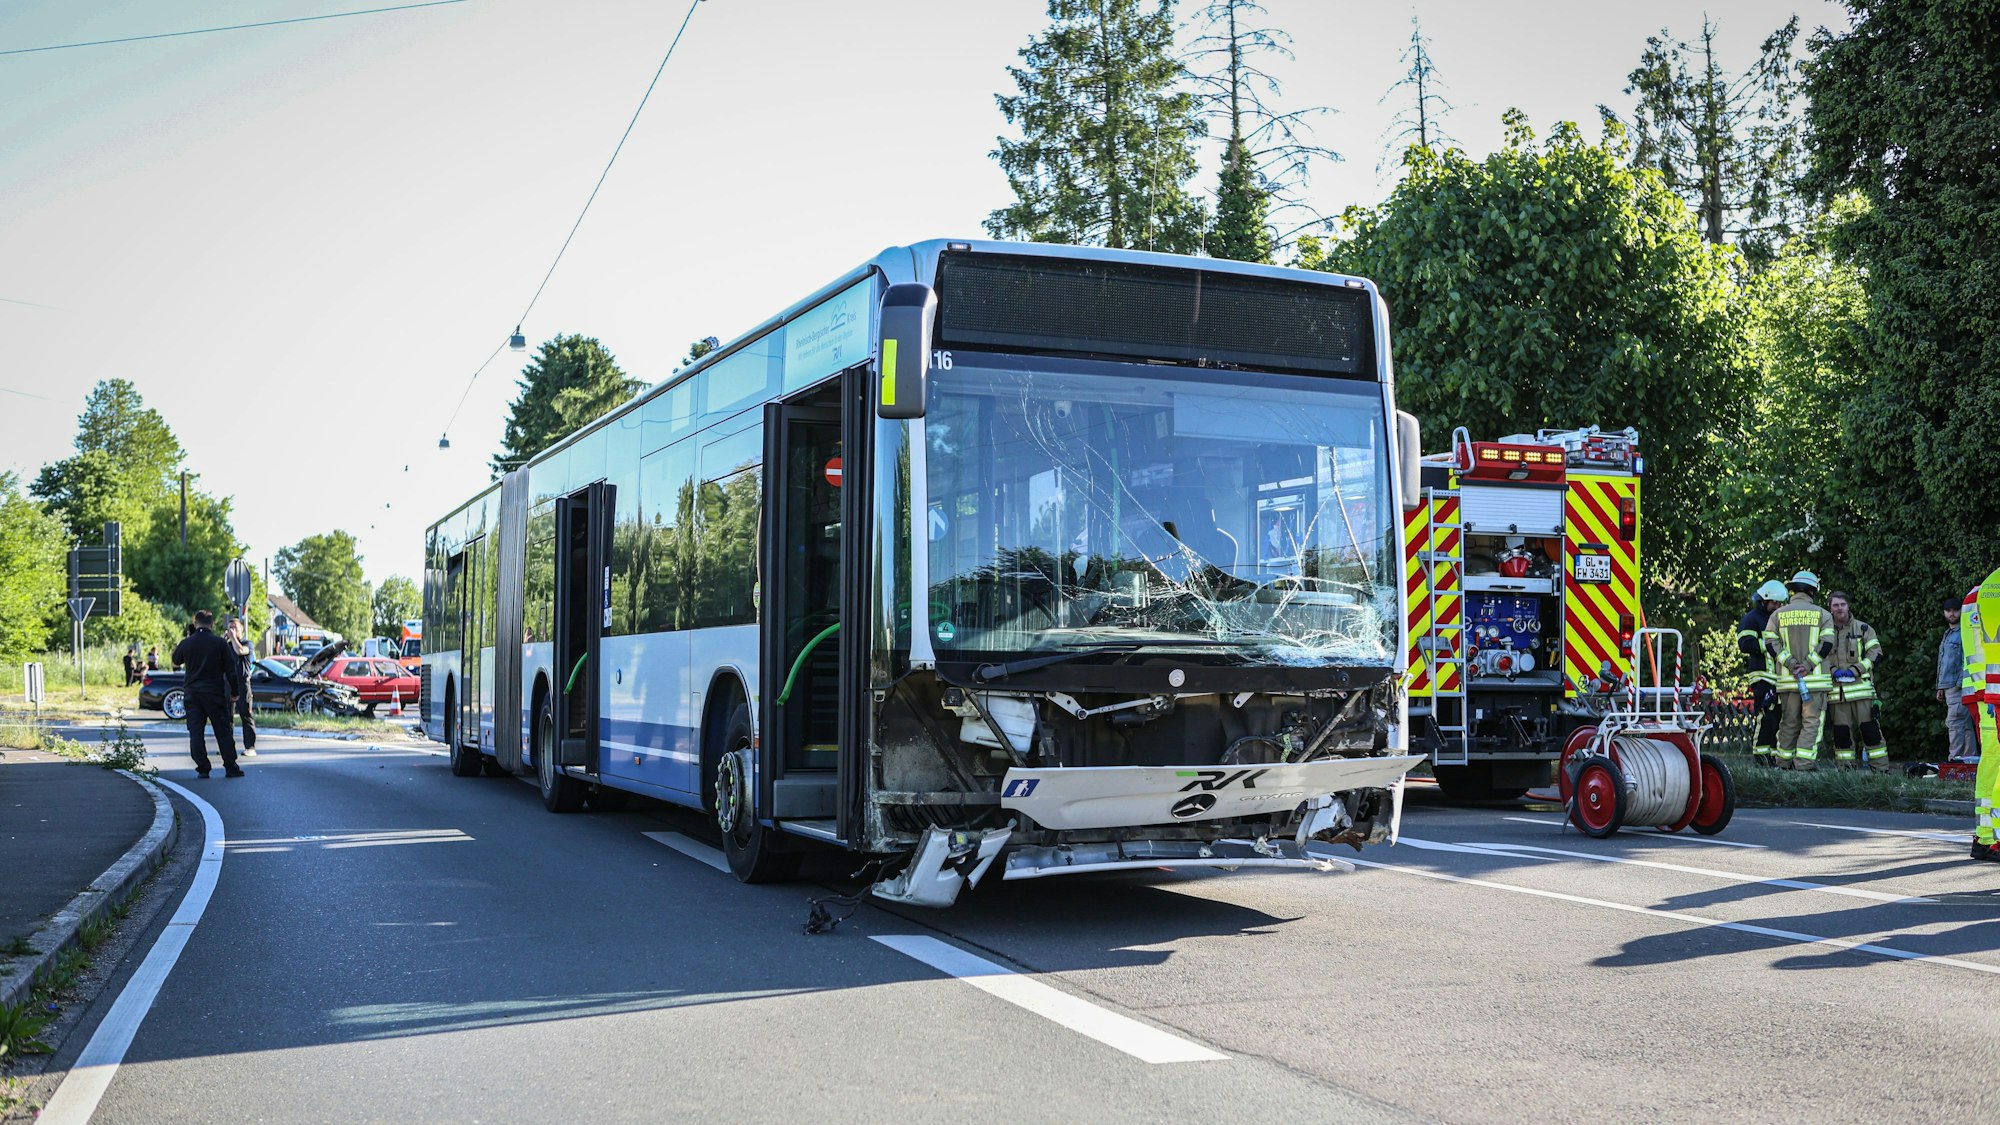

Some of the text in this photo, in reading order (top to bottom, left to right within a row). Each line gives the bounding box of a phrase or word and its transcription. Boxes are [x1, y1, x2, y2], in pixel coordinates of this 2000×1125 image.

[1585, 557, 1596, 567] GL
[1577, 568, 1609, 579] FW 3431
[1778, 610, 1820, 620] FEUERWEHR
[1780, 617, 1819, 627] BURSCHEID
